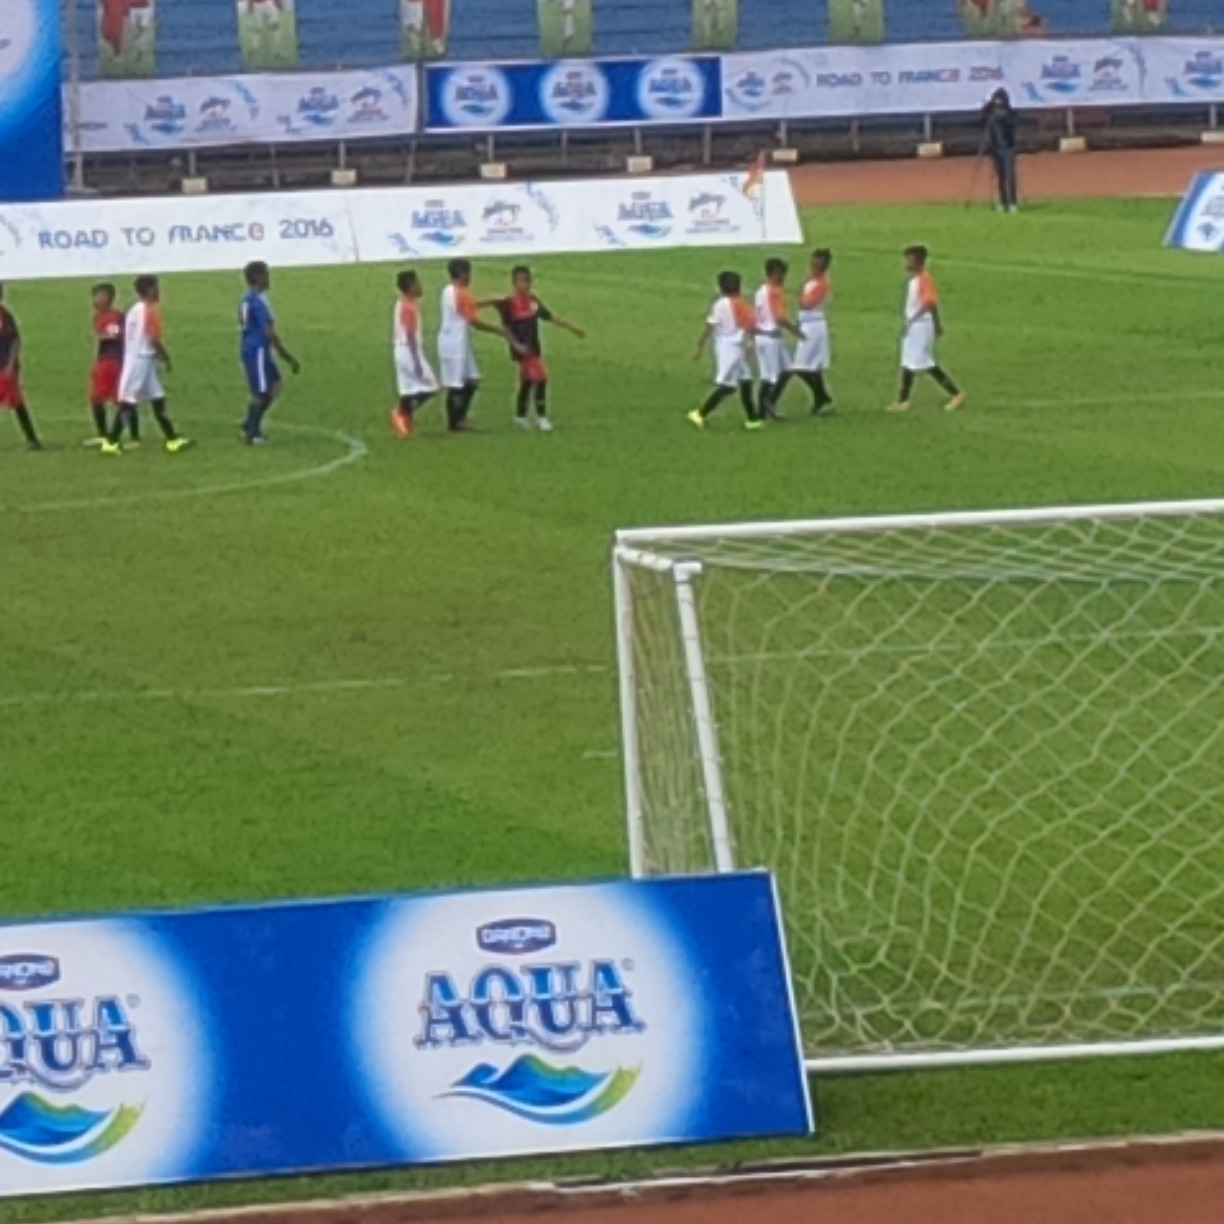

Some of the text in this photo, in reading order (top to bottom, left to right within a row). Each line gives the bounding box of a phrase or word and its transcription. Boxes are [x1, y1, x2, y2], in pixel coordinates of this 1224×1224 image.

[38, 230, 108, 249] ROAD
[121, 227, 155, 246] TO
[279, 218, 334, 239] 2016
[413, 958, 647, 1053] AQUA
